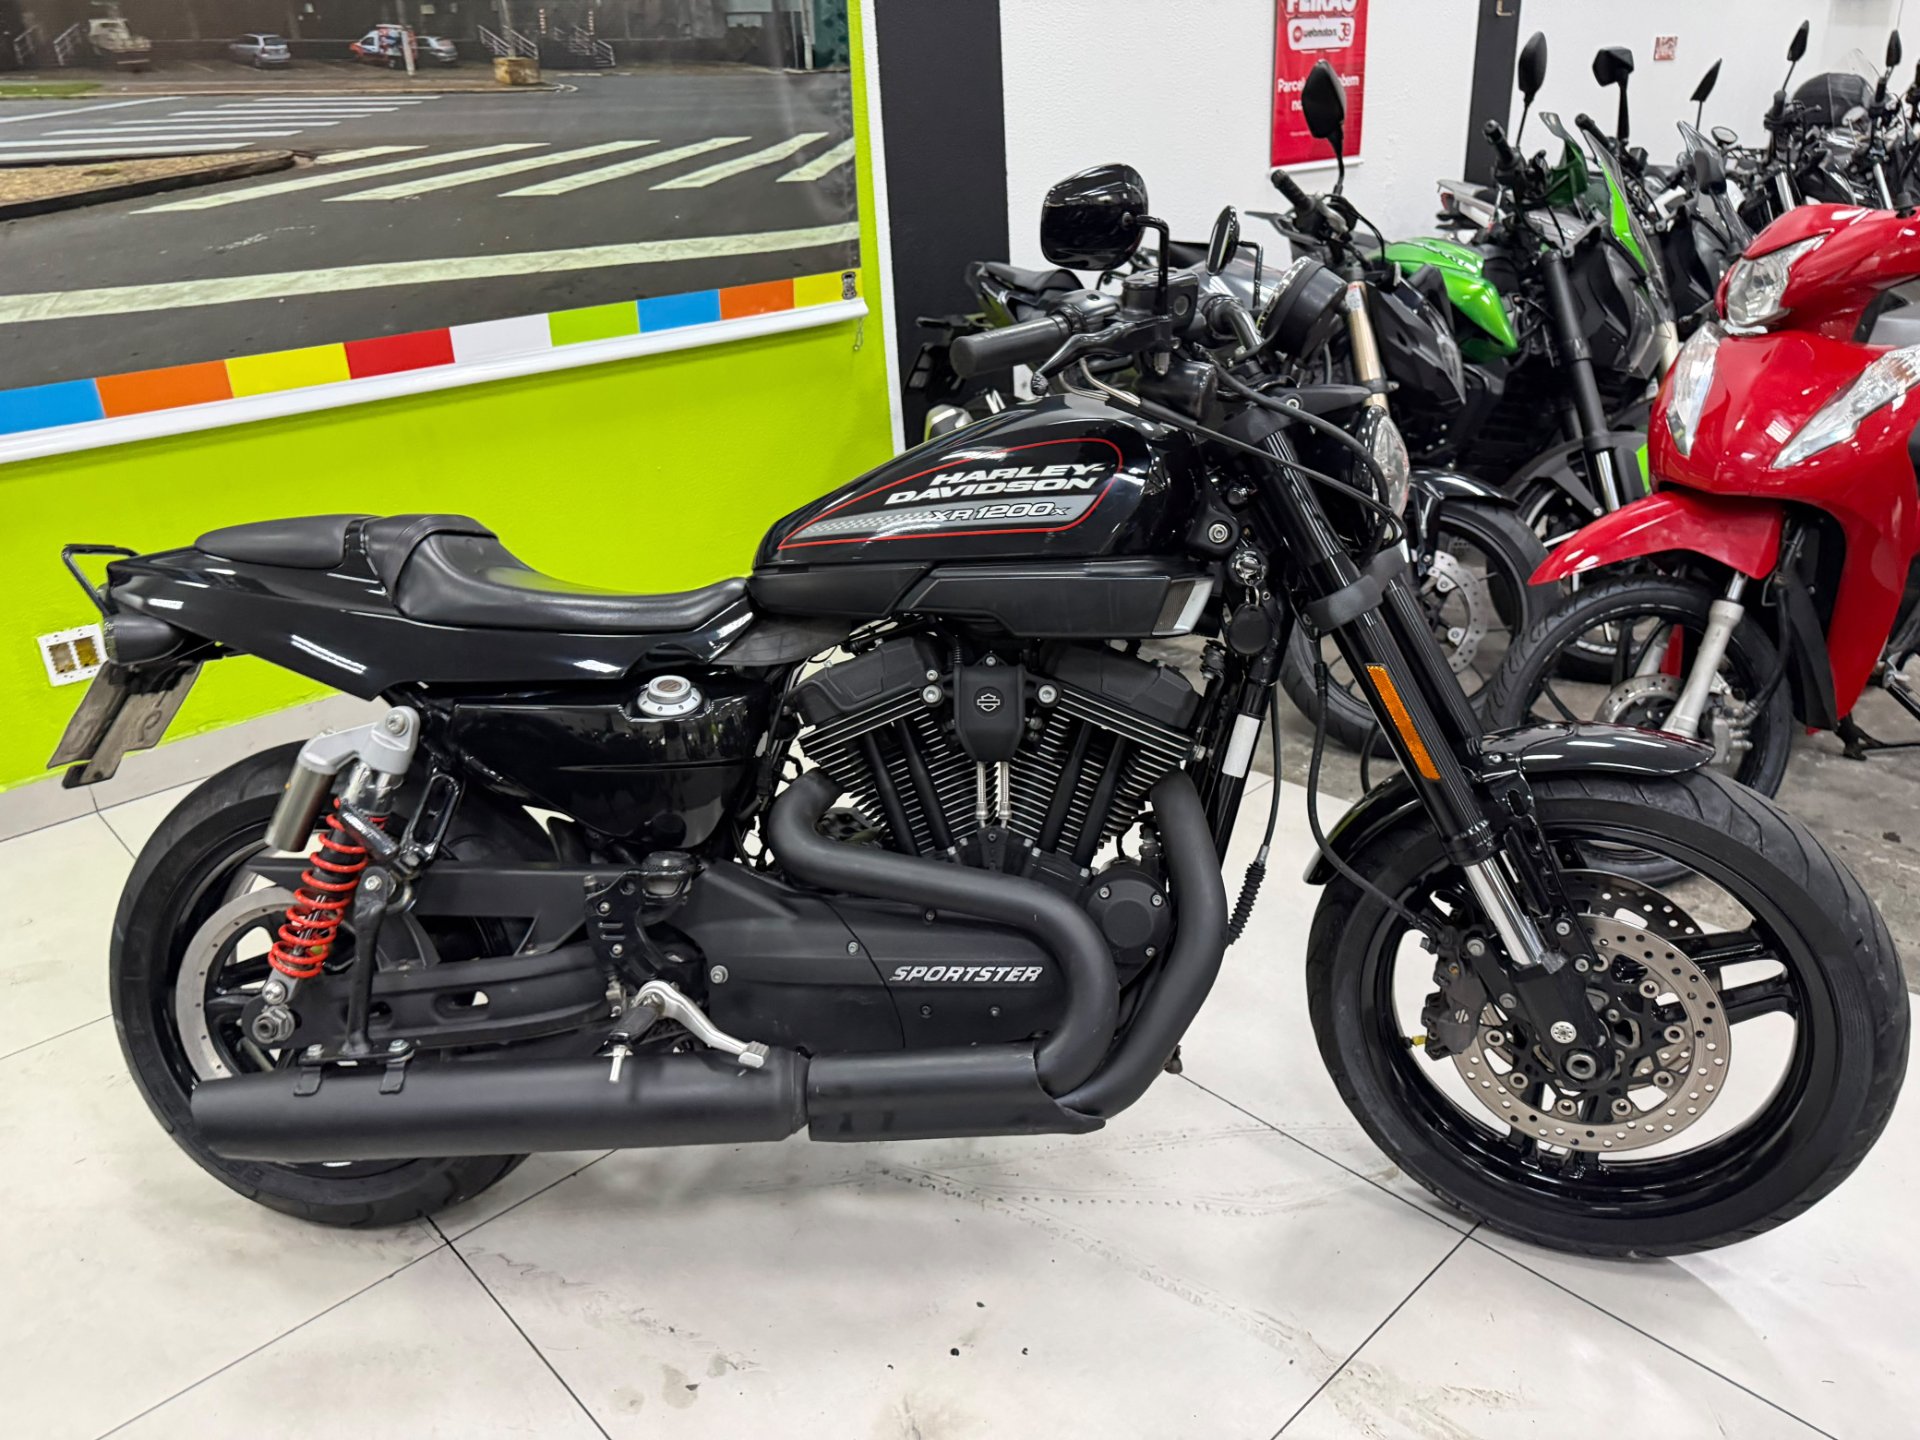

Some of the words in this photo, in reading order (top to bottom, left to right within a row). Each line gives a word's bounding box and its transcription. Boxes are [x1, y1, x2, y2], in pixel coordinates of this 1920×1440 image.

[928, 462, 1106, 487] HARLEY-
[884, 477, 1098, 506] DAVIDSON
[889, 965, 1044, 983] SPORTSTER
